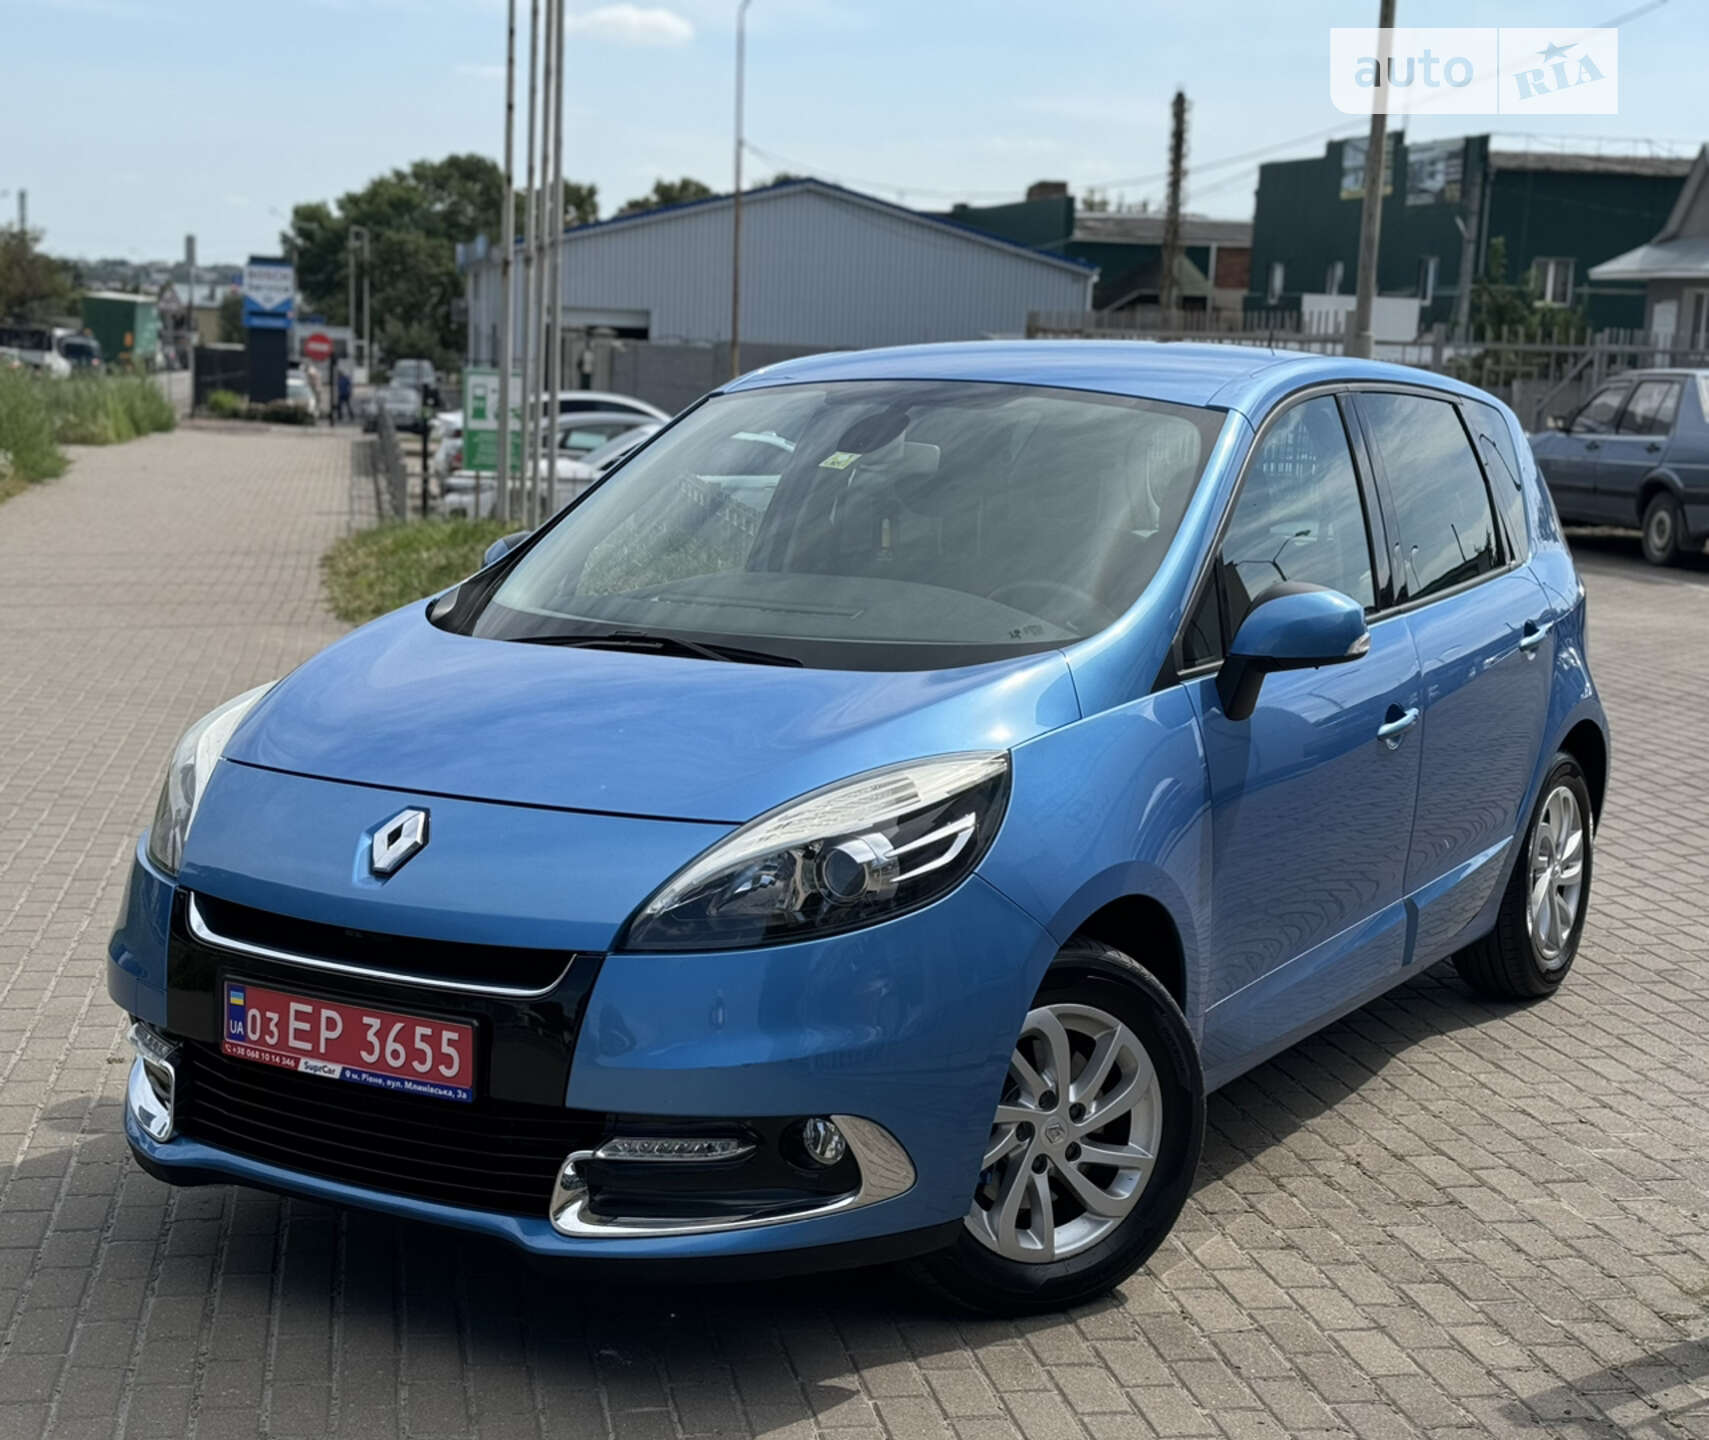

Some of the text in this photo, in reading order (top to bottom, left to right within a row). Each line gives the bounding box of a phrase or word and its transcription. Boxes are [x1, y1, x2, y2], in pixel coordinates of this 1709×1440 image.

[230, 1020, 244, 1035] UA
[360, 1016, 460, 1078] 3655
[304, 1061, 336, 1075] SuprCar
